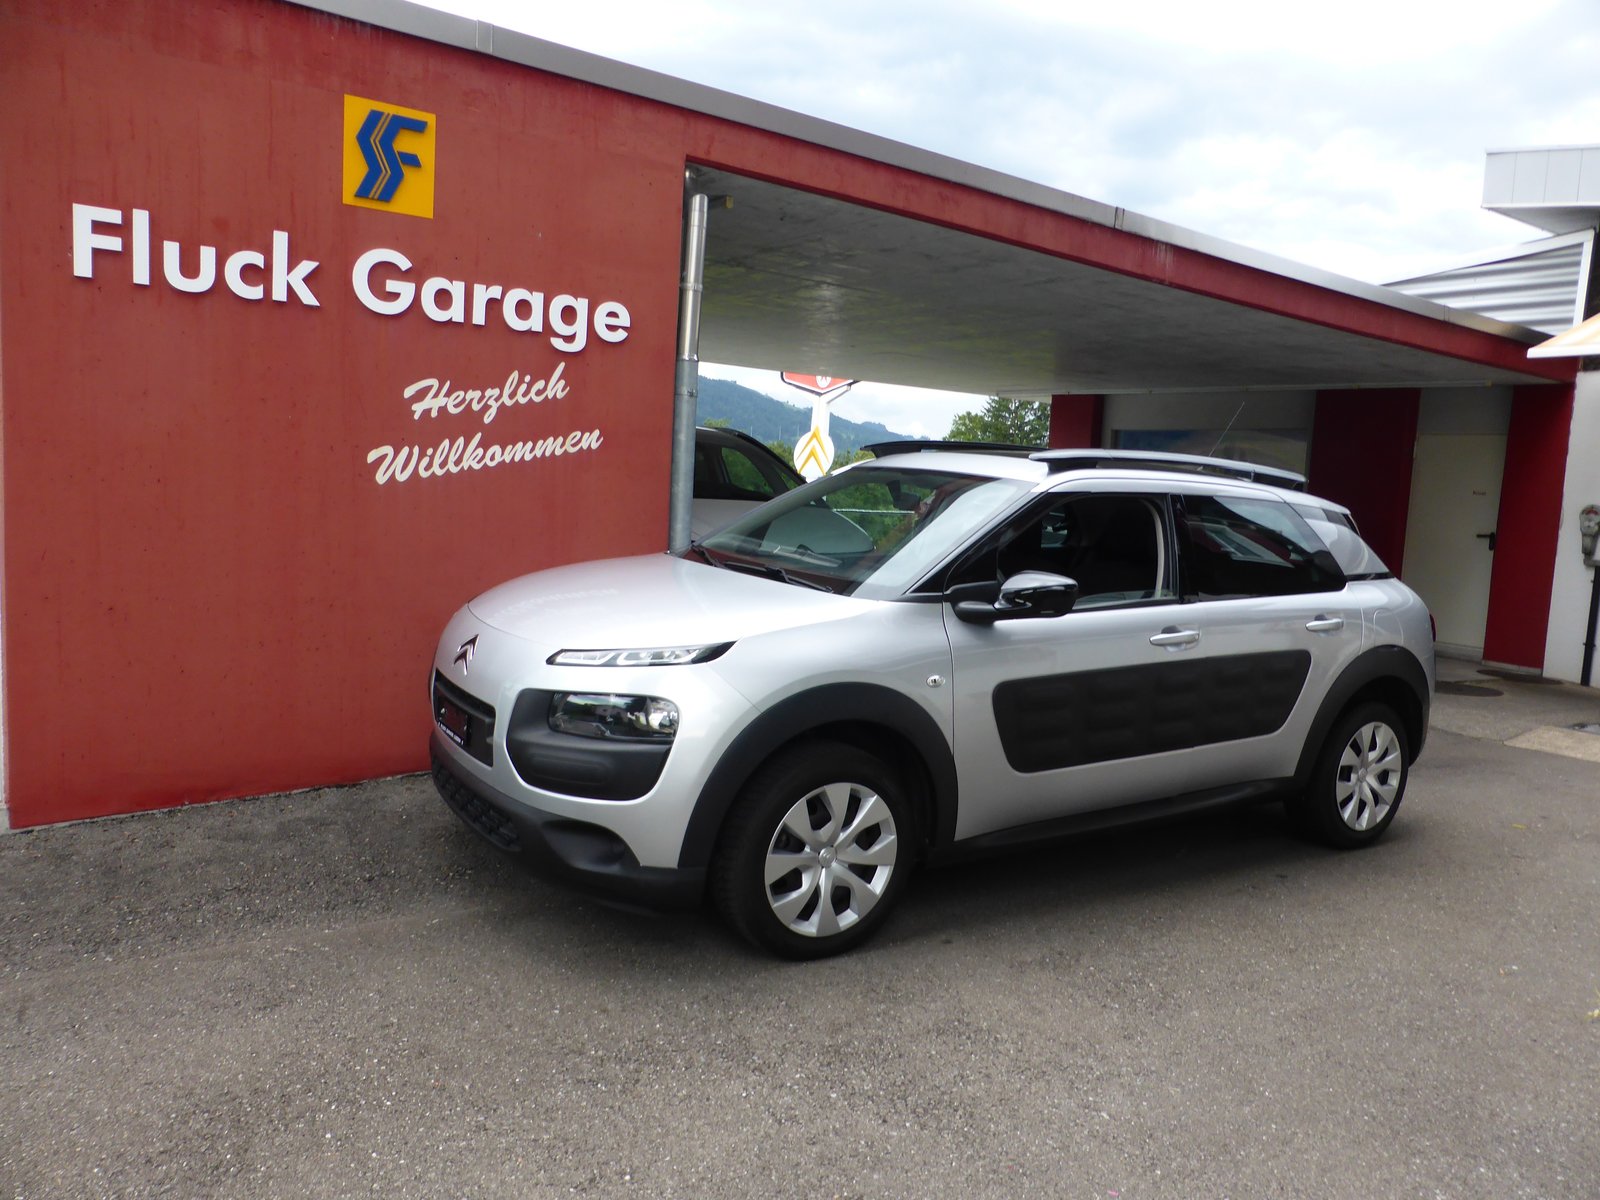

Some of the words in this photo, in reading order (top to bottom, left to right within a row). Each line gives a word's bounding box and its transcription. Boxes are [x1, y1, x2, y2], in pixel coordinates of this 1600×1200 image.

[72, 202, 321, 307] Fluck
[351, 247, 631, 353] Garage
[403, 361, 570, 425] Herzlich
[366, 426, 604, 485] Willkommen
